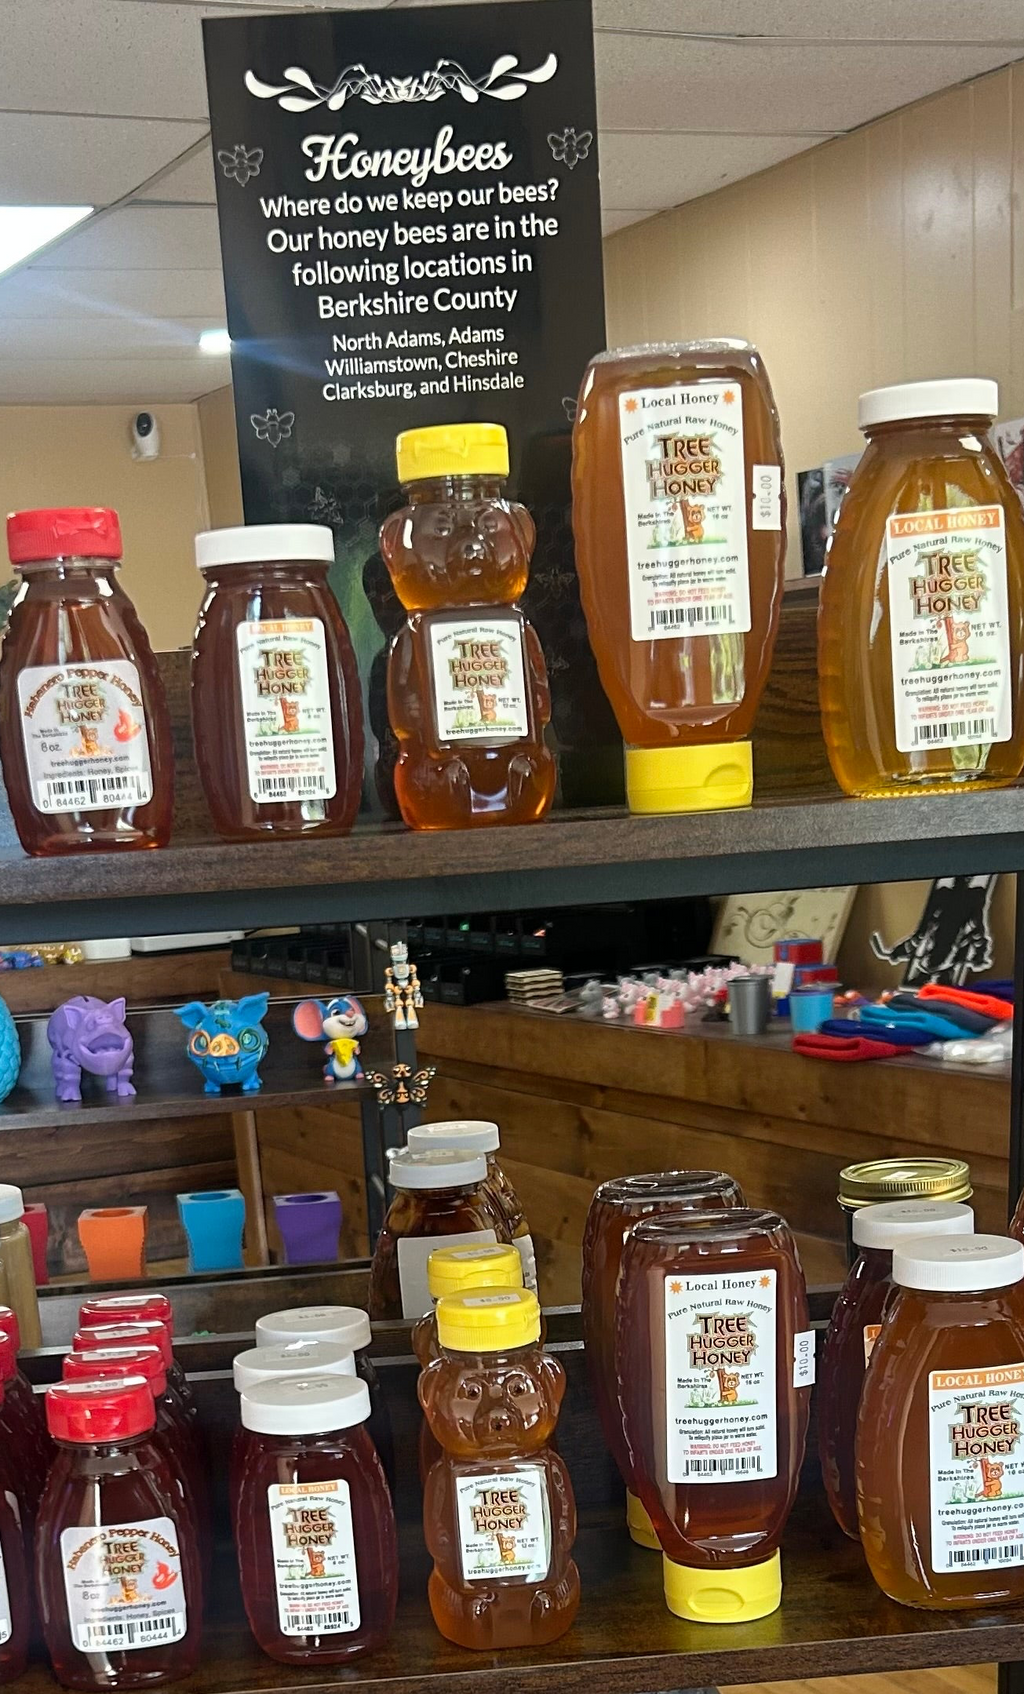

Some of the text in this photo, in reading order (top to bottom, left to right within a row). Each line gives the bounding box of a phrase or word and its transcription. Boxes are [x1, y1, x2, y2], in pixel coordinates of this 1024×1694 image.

[301, 124, 513, 188] Honeybees
[259, 178, 559, 219] Where do we keep our bees?
[267, 213, 559, 254] Our honey bees are in the
[291, 250, 533, 287] following locations in
[318, 287, 517, 319] Berkshire County
[332, 325, 505, 353] North Adams, Adams
[324, 349, 518, 377] Williamstown, Cheshire
[322, 372, 525, 402] Clarksburg, and Hinsdale
[641, 393, 720, 409] Local Honey
[623, 415, 739, 446] Pure Natural Raw Honey
[657, 437, 711, 461] TREE
[649, 459, 720, 478] HUGGER
[653, 478, 716, 498] HONEY
[894, 512, 996, 535] LOCAL HONEY
[889, 535, 1003, 565] Pure Natural Raw Honey
[637, 554, 739, 570] treehuggerhoney.com
[921, 553, 975, 577] TREE
[913, 576, 984, 595] HUGGER
[917, 595, 982, 615] HONEY
[970, 622, 986, 631] NET
[457, 642, 500, 660] TREE
[260, 651, 303, 668] TREE
[451, 660, 508, 673] HUGGER
[256, 668, 309, 680] HUGGER
[455, 674, 505, 688] HONEY
[901, 669, 1001, 686] treehuggerhoney.com
[61, 684, 99, 699] TREE
[66, 668, 110, 680] Pepper
[110, 675, 143, 708] Honey
[259, 682, 307, 695] HONEY
[61, 710, 104, 724] HONEY
[445, 725, 523, 736] treehuggerhoney.com
[40, 741, 48, 753] 8
[50, 755, 130, 768] treehuggerhoney.com
[56, 796, 87, 807] 84462
[685, 1279, 758, 1292] Local Honey
[667, 1298, 773, 1320] Pure Natural Raw Honey
[699, 1316, 747, 1336] TREE
[690, 1334, 754, 1349] HUGGER
[693, 1350, 751, 1366] HONEY
[798, 1340, 809, 1377] $10.00
[936, 1374, 983, 1387] LOCAL
[931, 1389, 1008, 1413] Pure Natural Raw
[675, 1413, 768, 1426] treehuggerhoney.com
[961, 1403, 1010, 1425] TREE
[952, 1422, 1019, 1440] HUGGER
[955, 1439, 1014, 1457] HONEY
[308, 1482, 336, 1493] HONEY
[479, 1490, 518, 1506] TREE
[290, 1509, 328, 1524] TREE
[473, 1505, 526, 1518] HUGGER
[285, 1522, 334, 1534] HUGGER
[476, 1518, 523, 1532] HONEY
[103, 1541, 139, 1554] TREE
[108, 1528, 150, 1538] Pepper
[149, 1531, 181, 1558] Honey
[288, 1534, 332, 1546] HONEY
[103, 1563, 144, 1576] HONEY
[82, 1591, 90, 1600] 8
[82, 1638, 89, 1647] 0
[140, 1632, 168, 1643] 80444
